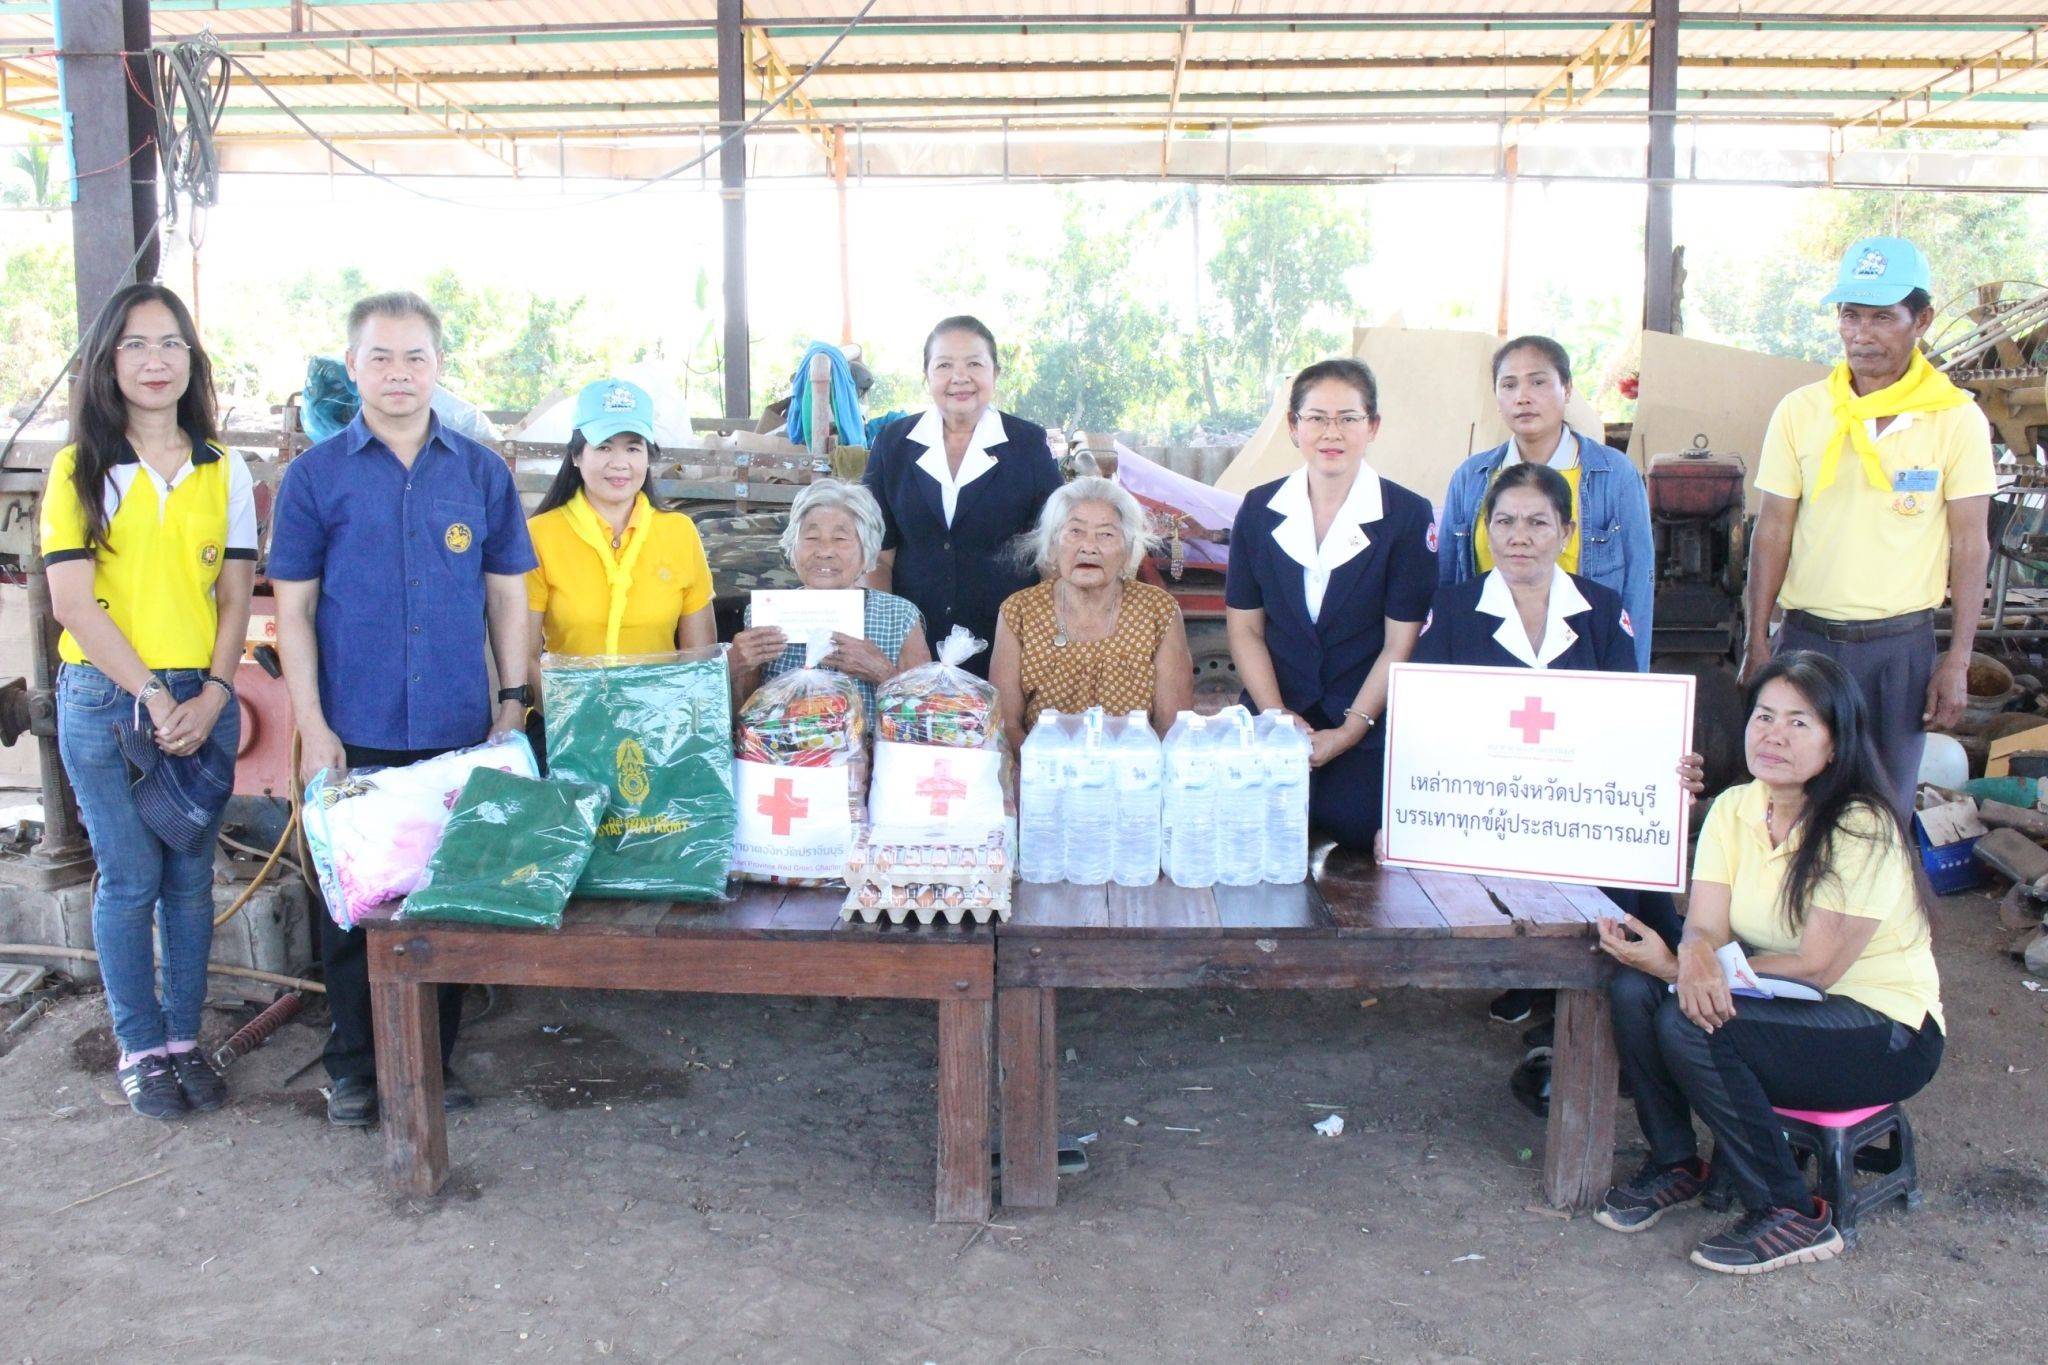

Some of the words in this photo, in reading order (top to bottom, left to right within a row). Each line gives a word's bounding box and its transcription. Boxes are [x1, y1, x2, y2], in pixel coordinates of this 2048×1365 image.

[1410, 770, 1656, 816] เหล่ากาชาดจังหวัดปราจีนบุรี
[1395, 807, 1670, 846] บรรเทาทุกข์ผู้ประสบสาธารณภัย
